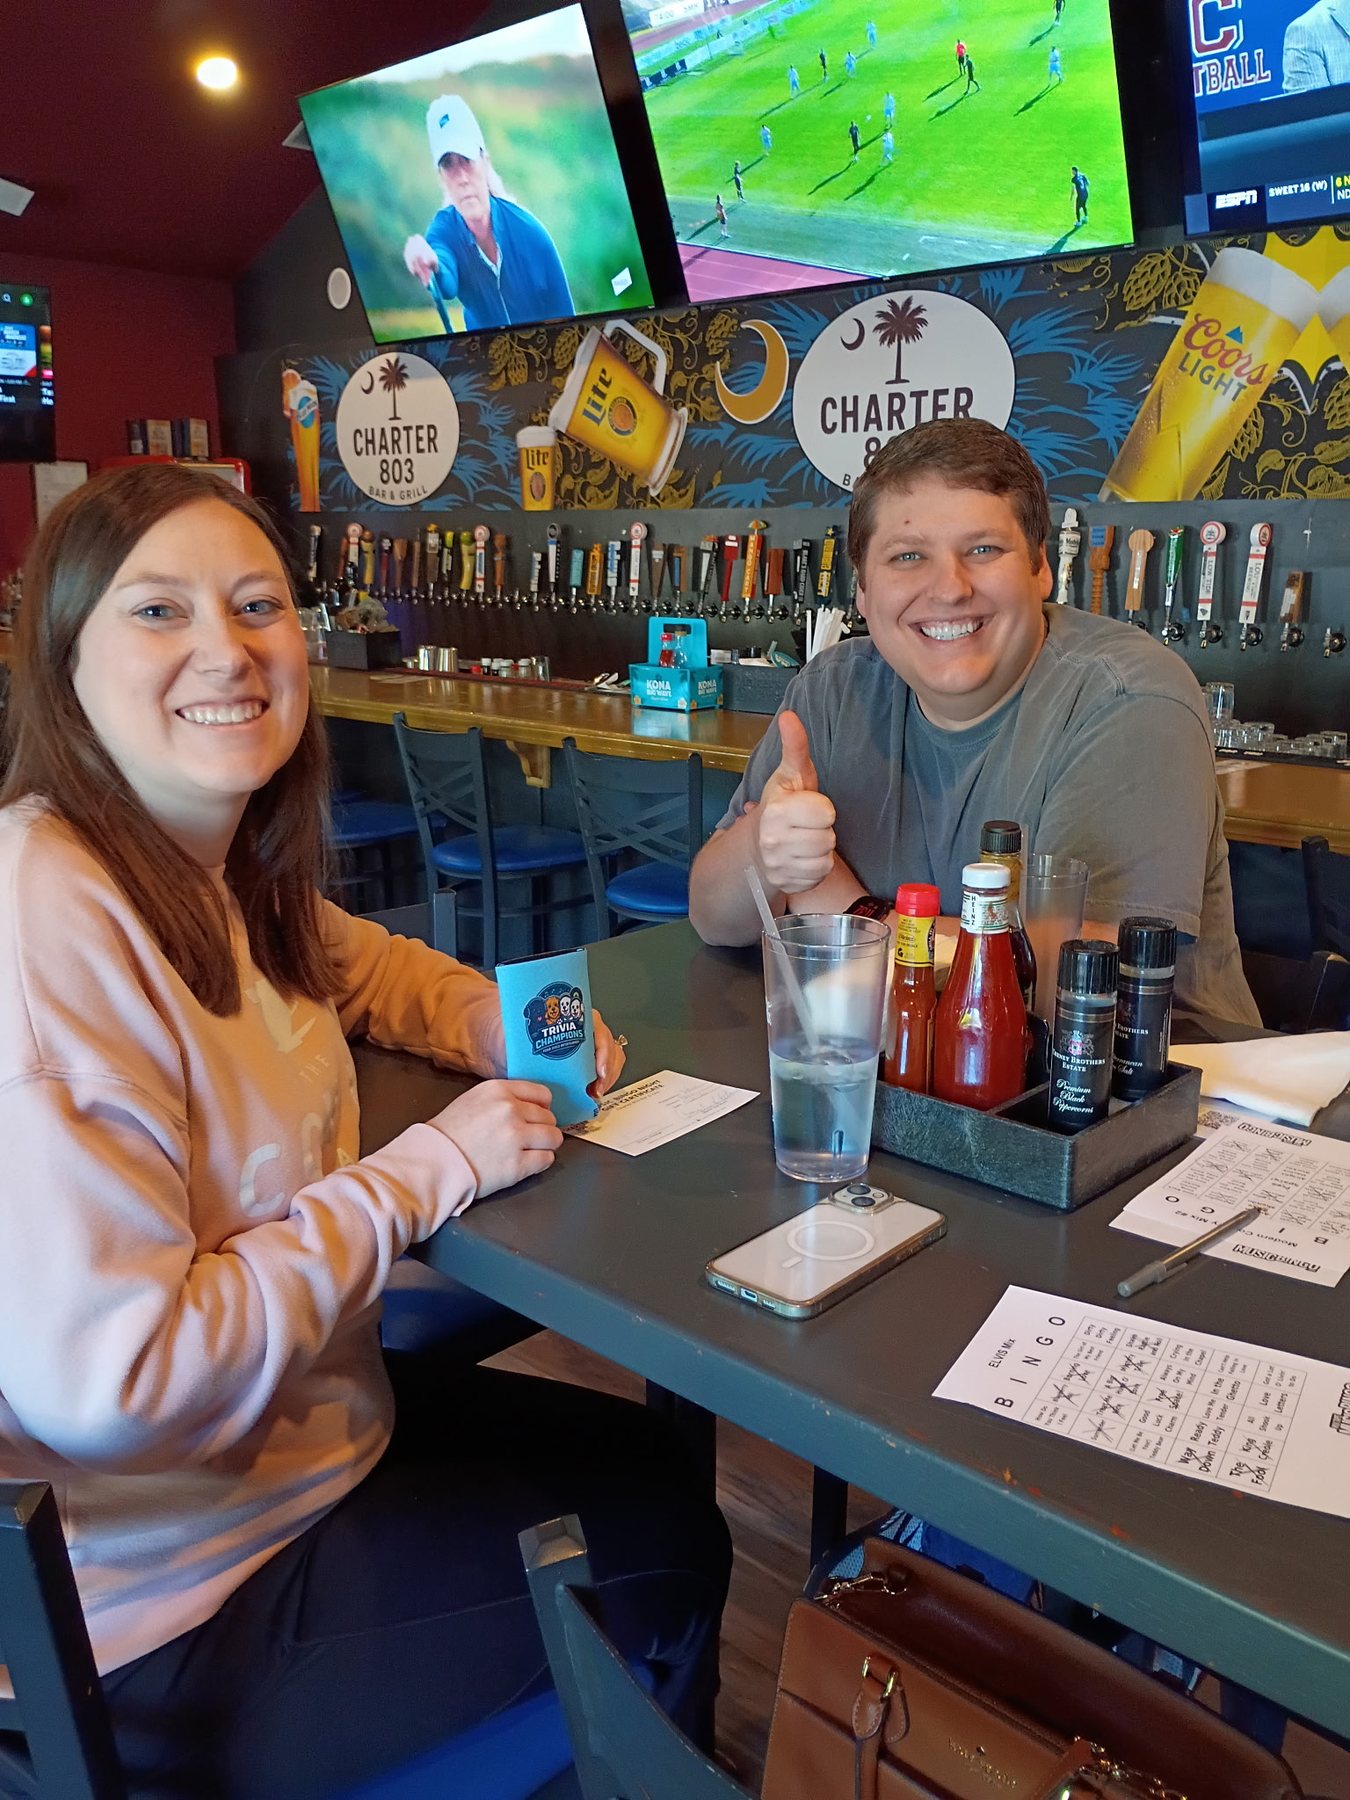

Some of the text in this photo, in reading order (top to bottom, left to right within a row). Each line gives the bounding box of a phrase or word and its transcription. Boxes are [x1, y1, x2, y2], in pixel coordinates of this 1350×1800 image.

[1268, 179, 1328, 198] SWEET 16 (W)
[1216, 189, 1258, 209] ESPN
[1183, 312, 1268, 386] Coors
[1178, 351, 1248, 402] LIGHT
[581, 367, 613, 428] Lite
[820, 386, 974, 435] CHARTER
[353, 424, 439, 457] CHARTER
[525, 448, 550, 471] Lite
[379, 458, 415, 485] 803
[368, 485, 387, 499] BAR
[400, 485, 428, 500] GRILL
[646, 680, 671, 691] KONA
[698, 680, 717, 690] KONA
[535, 1029, 584, 1049] CHAMPIONS
[541, 1021, 577, 1038] TRIVIA
[1062, 1062, 1087, 1072] ESTATE
[1071, 1056, 1106, 1065] BROTHERS
[1056, 1078, 1092, 1094] Premium
[1052, 1096, 1094, 1113] Peppercorns
[1060, 1090, 1086, 1103] Black
[1083, 1323, 1096, 1335] Dirty
[1106, 1327, 1120, 1343] Feeling
[988, 1337, 1016, 1367] ELVIS Mix
[994, 1395, 1014, 1409] B
[1022, 1355, 1042, 1367] N
[1035, 1335, 1054, 1346] G
[1048, 1316, 1066, 1326] O
[1213, 1377, 1224, 1387] the
[1225, 1380, 1240, 1400] Ghetto
[1258, 1391, 1270, 1405] Love
[1274, 1392, 1288, 1412] Letters
[1138, 1409, 1150, 1423] Good
[1190, 1421, 1207, 1442] Ready
[1208, 1425, 1225, 1447] Teddy
[1241, 1437, 1255, 1452] King
[1258, 1439, 1272, 1460] Creole
[1178, 1446, 1196, 1465] Way
[1198, 1450, 1216, 1472] Down
[1229, 1460, 1244, 1478] The
[1251, 1465, 1267, 1484] Fool
